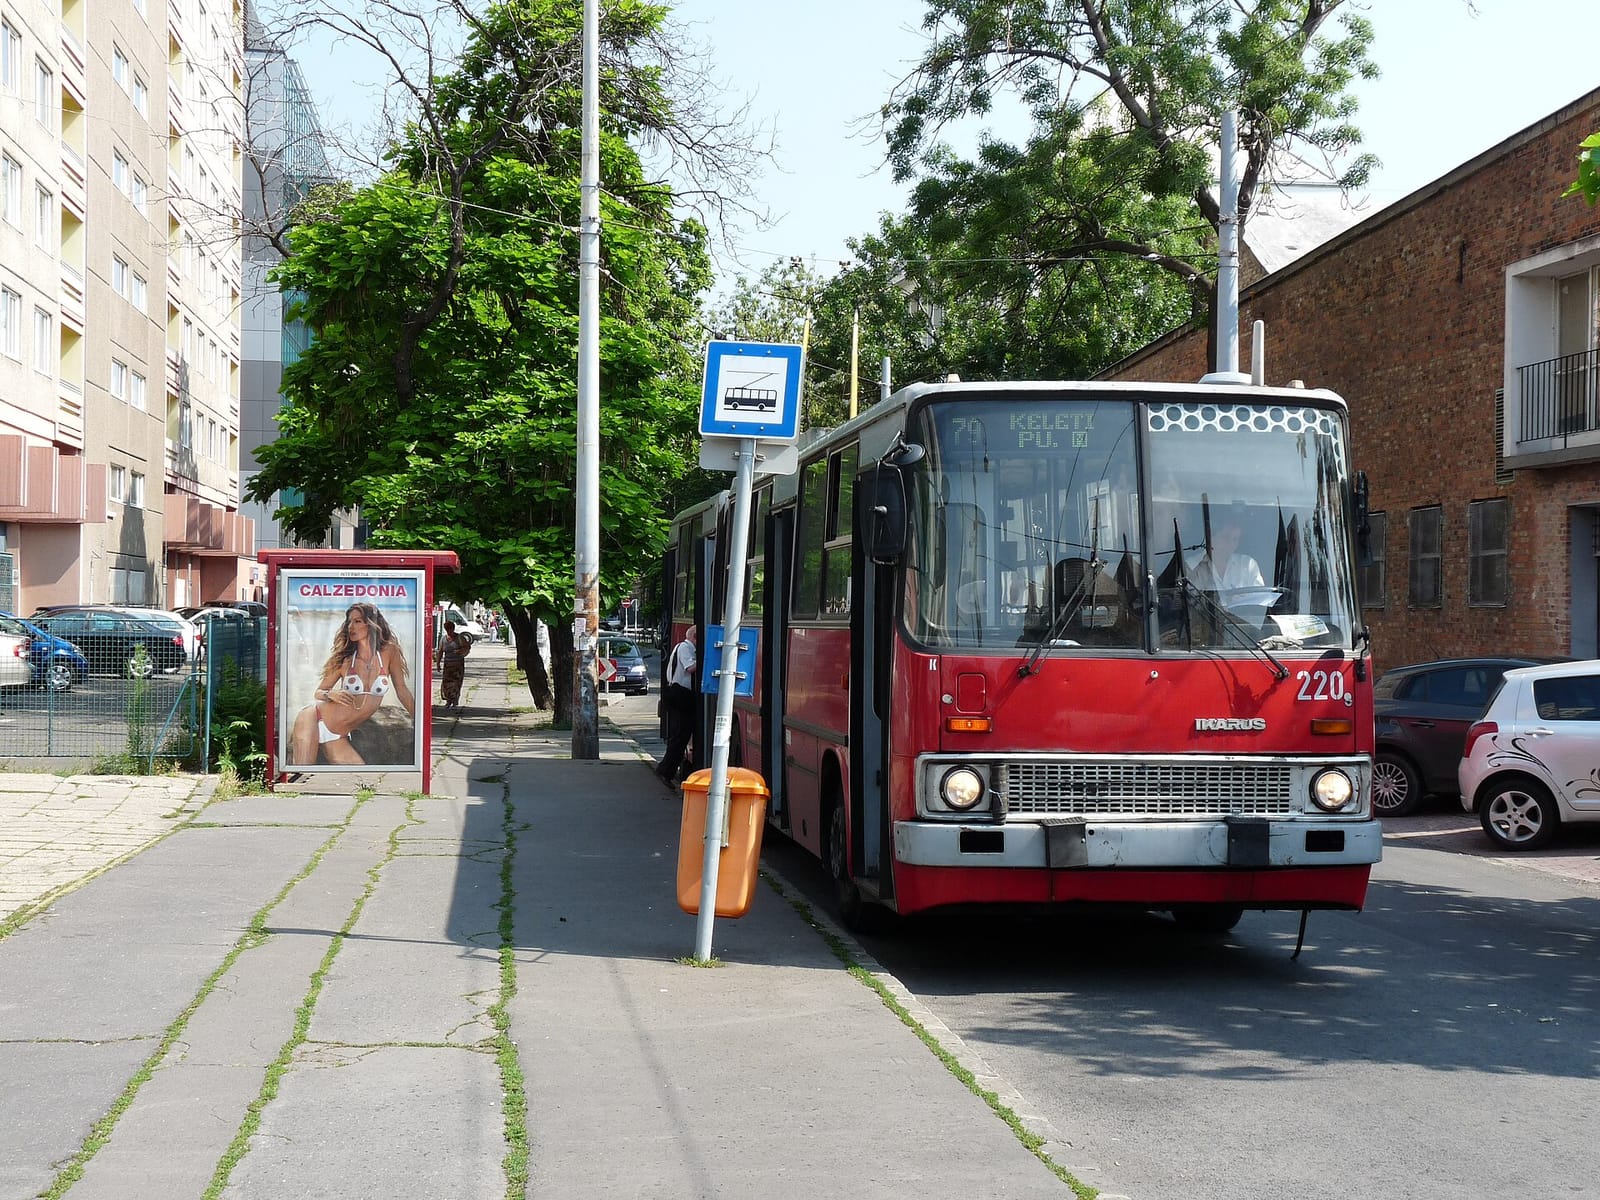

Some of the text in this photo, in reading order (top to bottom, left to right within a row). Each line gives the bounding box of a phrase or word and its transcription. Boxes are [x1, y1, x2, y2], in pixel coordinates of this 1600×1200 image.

[952, 412, 1095, 446] 79 KELETI
[1018, 431, 1059, 448] PU.
[299, 584, 408, 597] CALZEDONIA
[1296, 670, 1344, 701] 220
[1194, 717, 1267, 731] IKARUS
